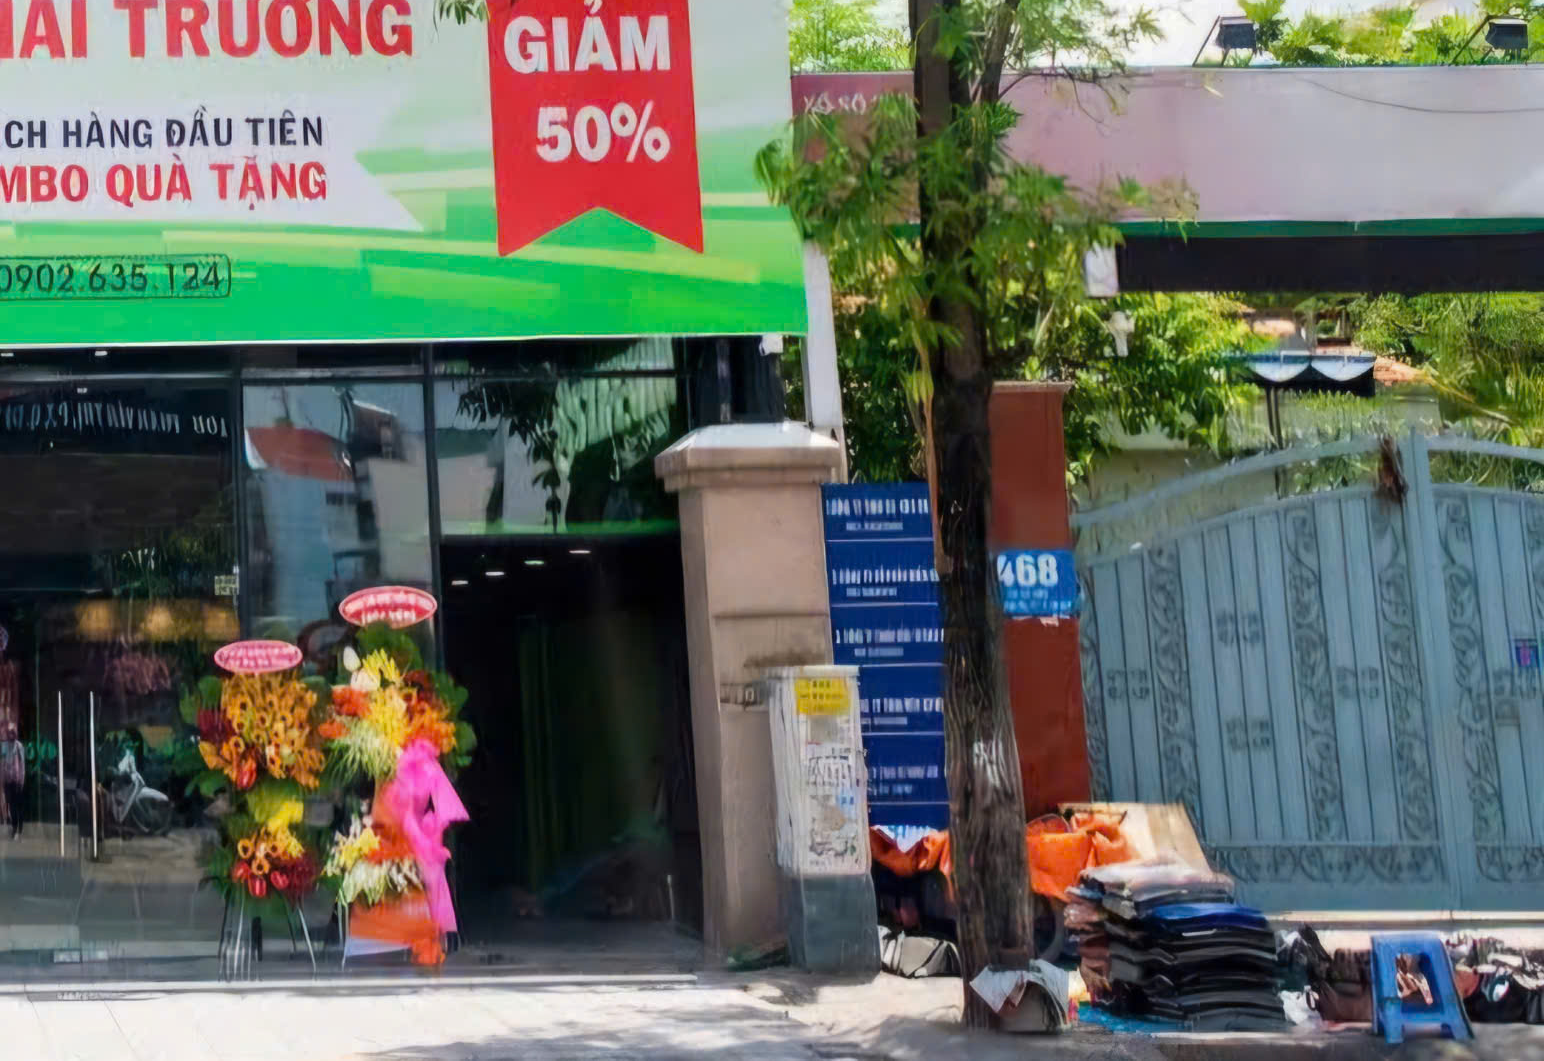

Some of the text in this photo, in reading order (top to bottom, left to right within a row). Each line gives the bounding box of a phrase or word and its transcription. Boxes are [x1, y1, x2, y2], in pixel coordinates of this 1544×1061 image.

[62, 111, 154, 149] HÀNG
[165, 107, 234, 148] ĐẦU
[244, 108, 324, 147] TIÊN
[536, 100, 671, 163] 50%
[105, 154, 192, 204] QUÀ
[209, 151, 328, 211] TẶNG
[997, 553, 1059, 588] 468
